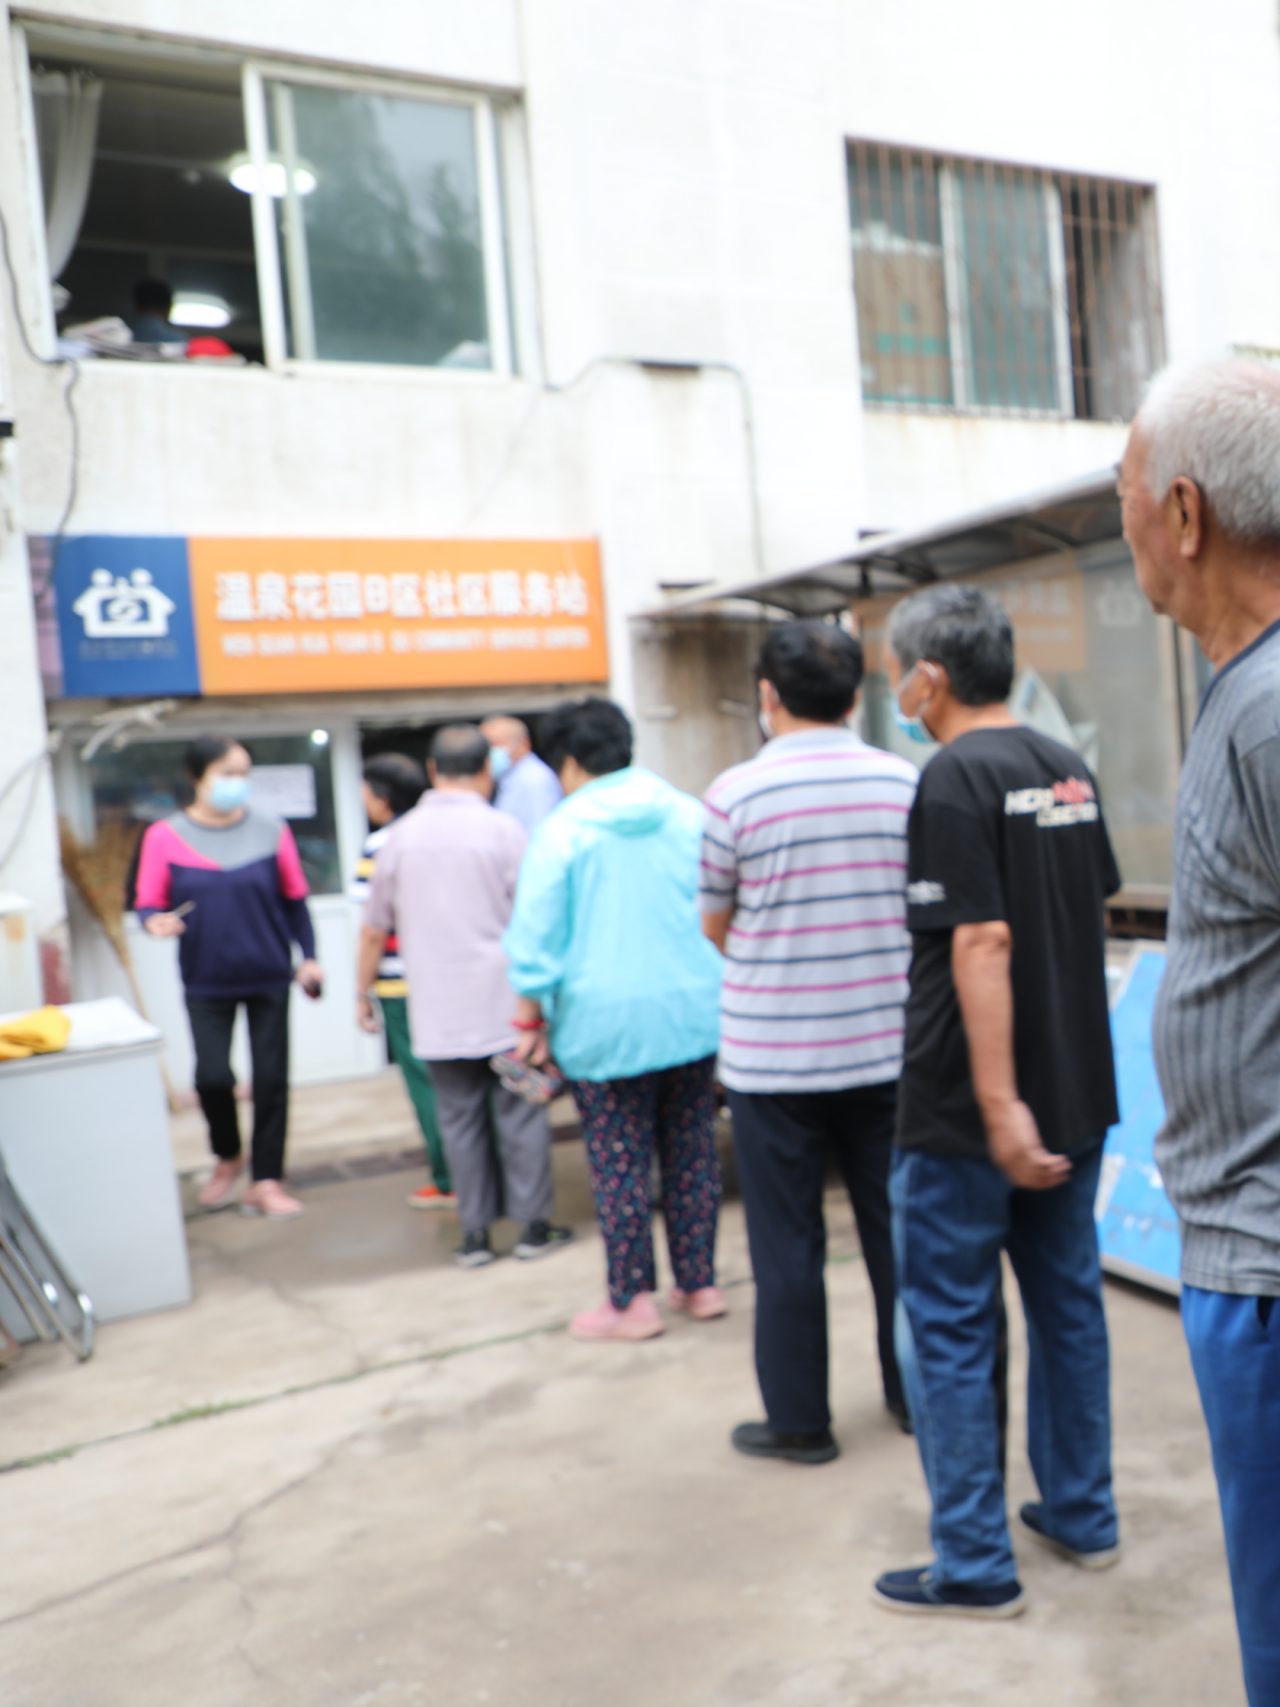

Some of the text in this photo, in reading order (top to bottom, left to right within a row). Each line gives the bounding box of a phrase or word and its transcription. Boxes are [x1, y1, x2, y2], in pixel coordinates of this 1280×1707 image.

[215, 569, 589, 621] 温泉花园B区社区服务站
